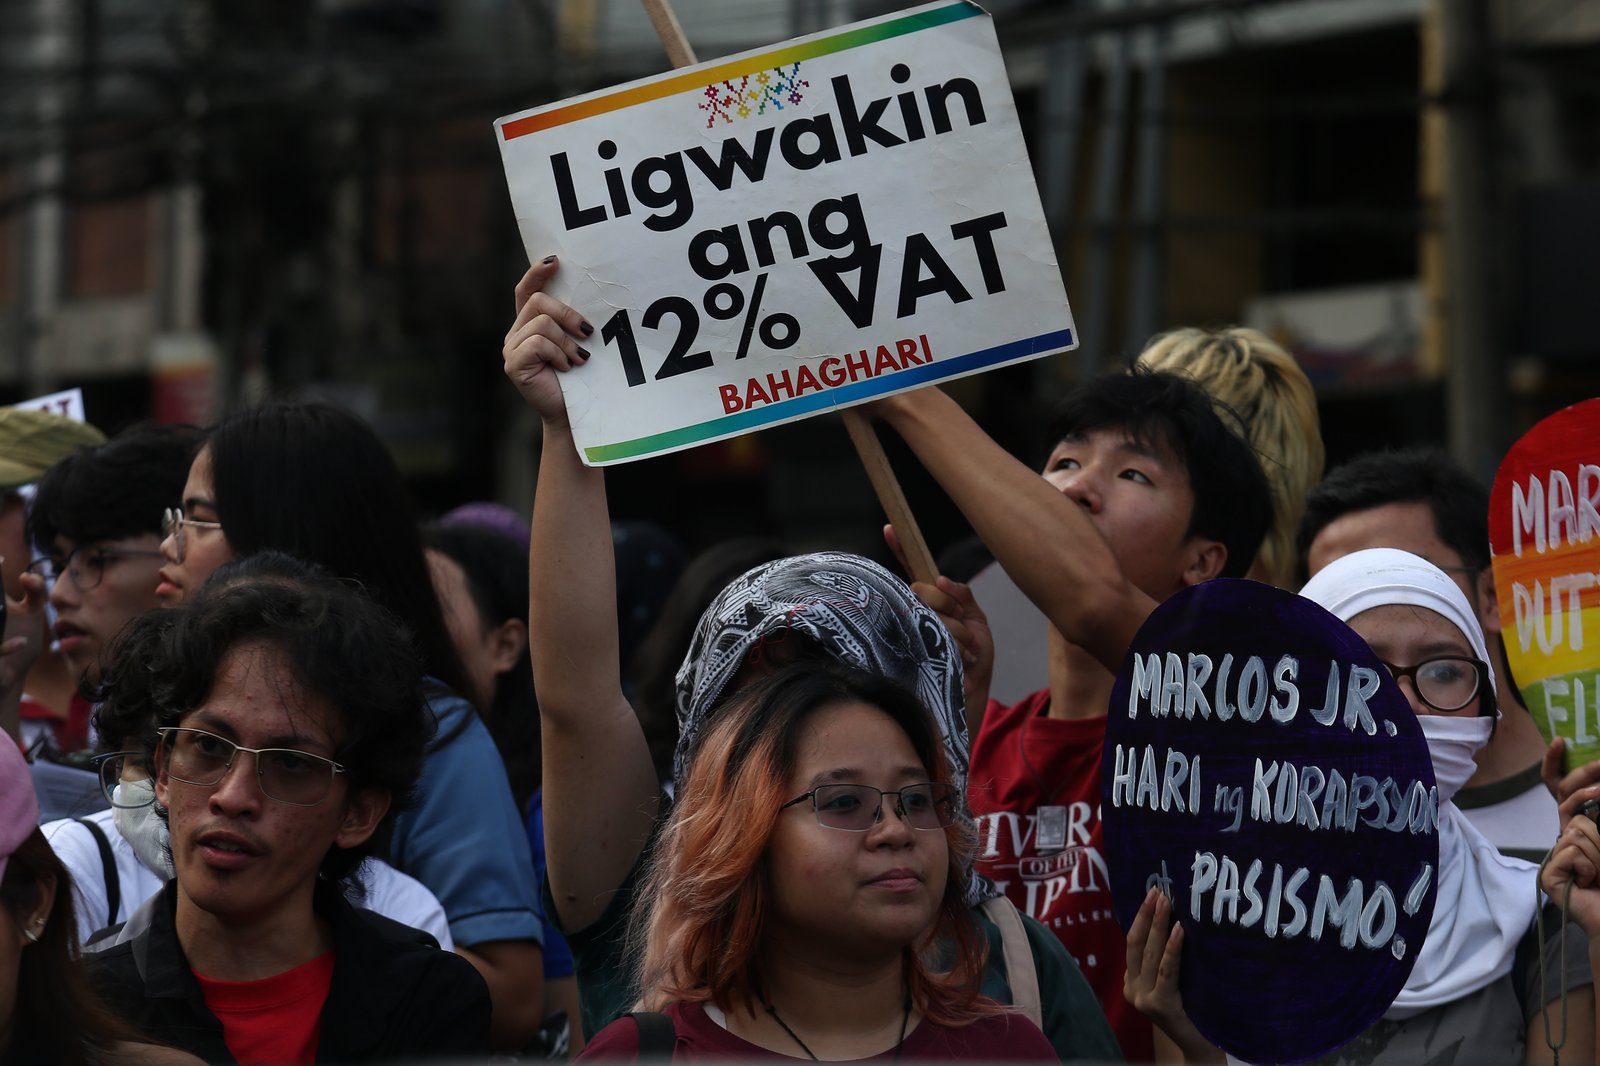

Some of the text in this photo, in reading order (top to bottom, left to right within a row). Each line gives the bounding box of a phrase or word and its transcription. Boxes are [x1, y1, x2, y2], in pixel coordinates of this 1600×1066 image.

[550, 63, 987, 232] Ligwakin
[688, 193, 874, 281] ang
[600, 273, 801, 387] 12%
[719, 334, 934, 414] BAHAGHARI
[1129, 652, 1398, 736] MARCOS JR.
[1113, 743, 1201, 815] HARI
[1214, 784, 1244, 832] ng
[1190, 850, 1434, 961] PASISMO!
